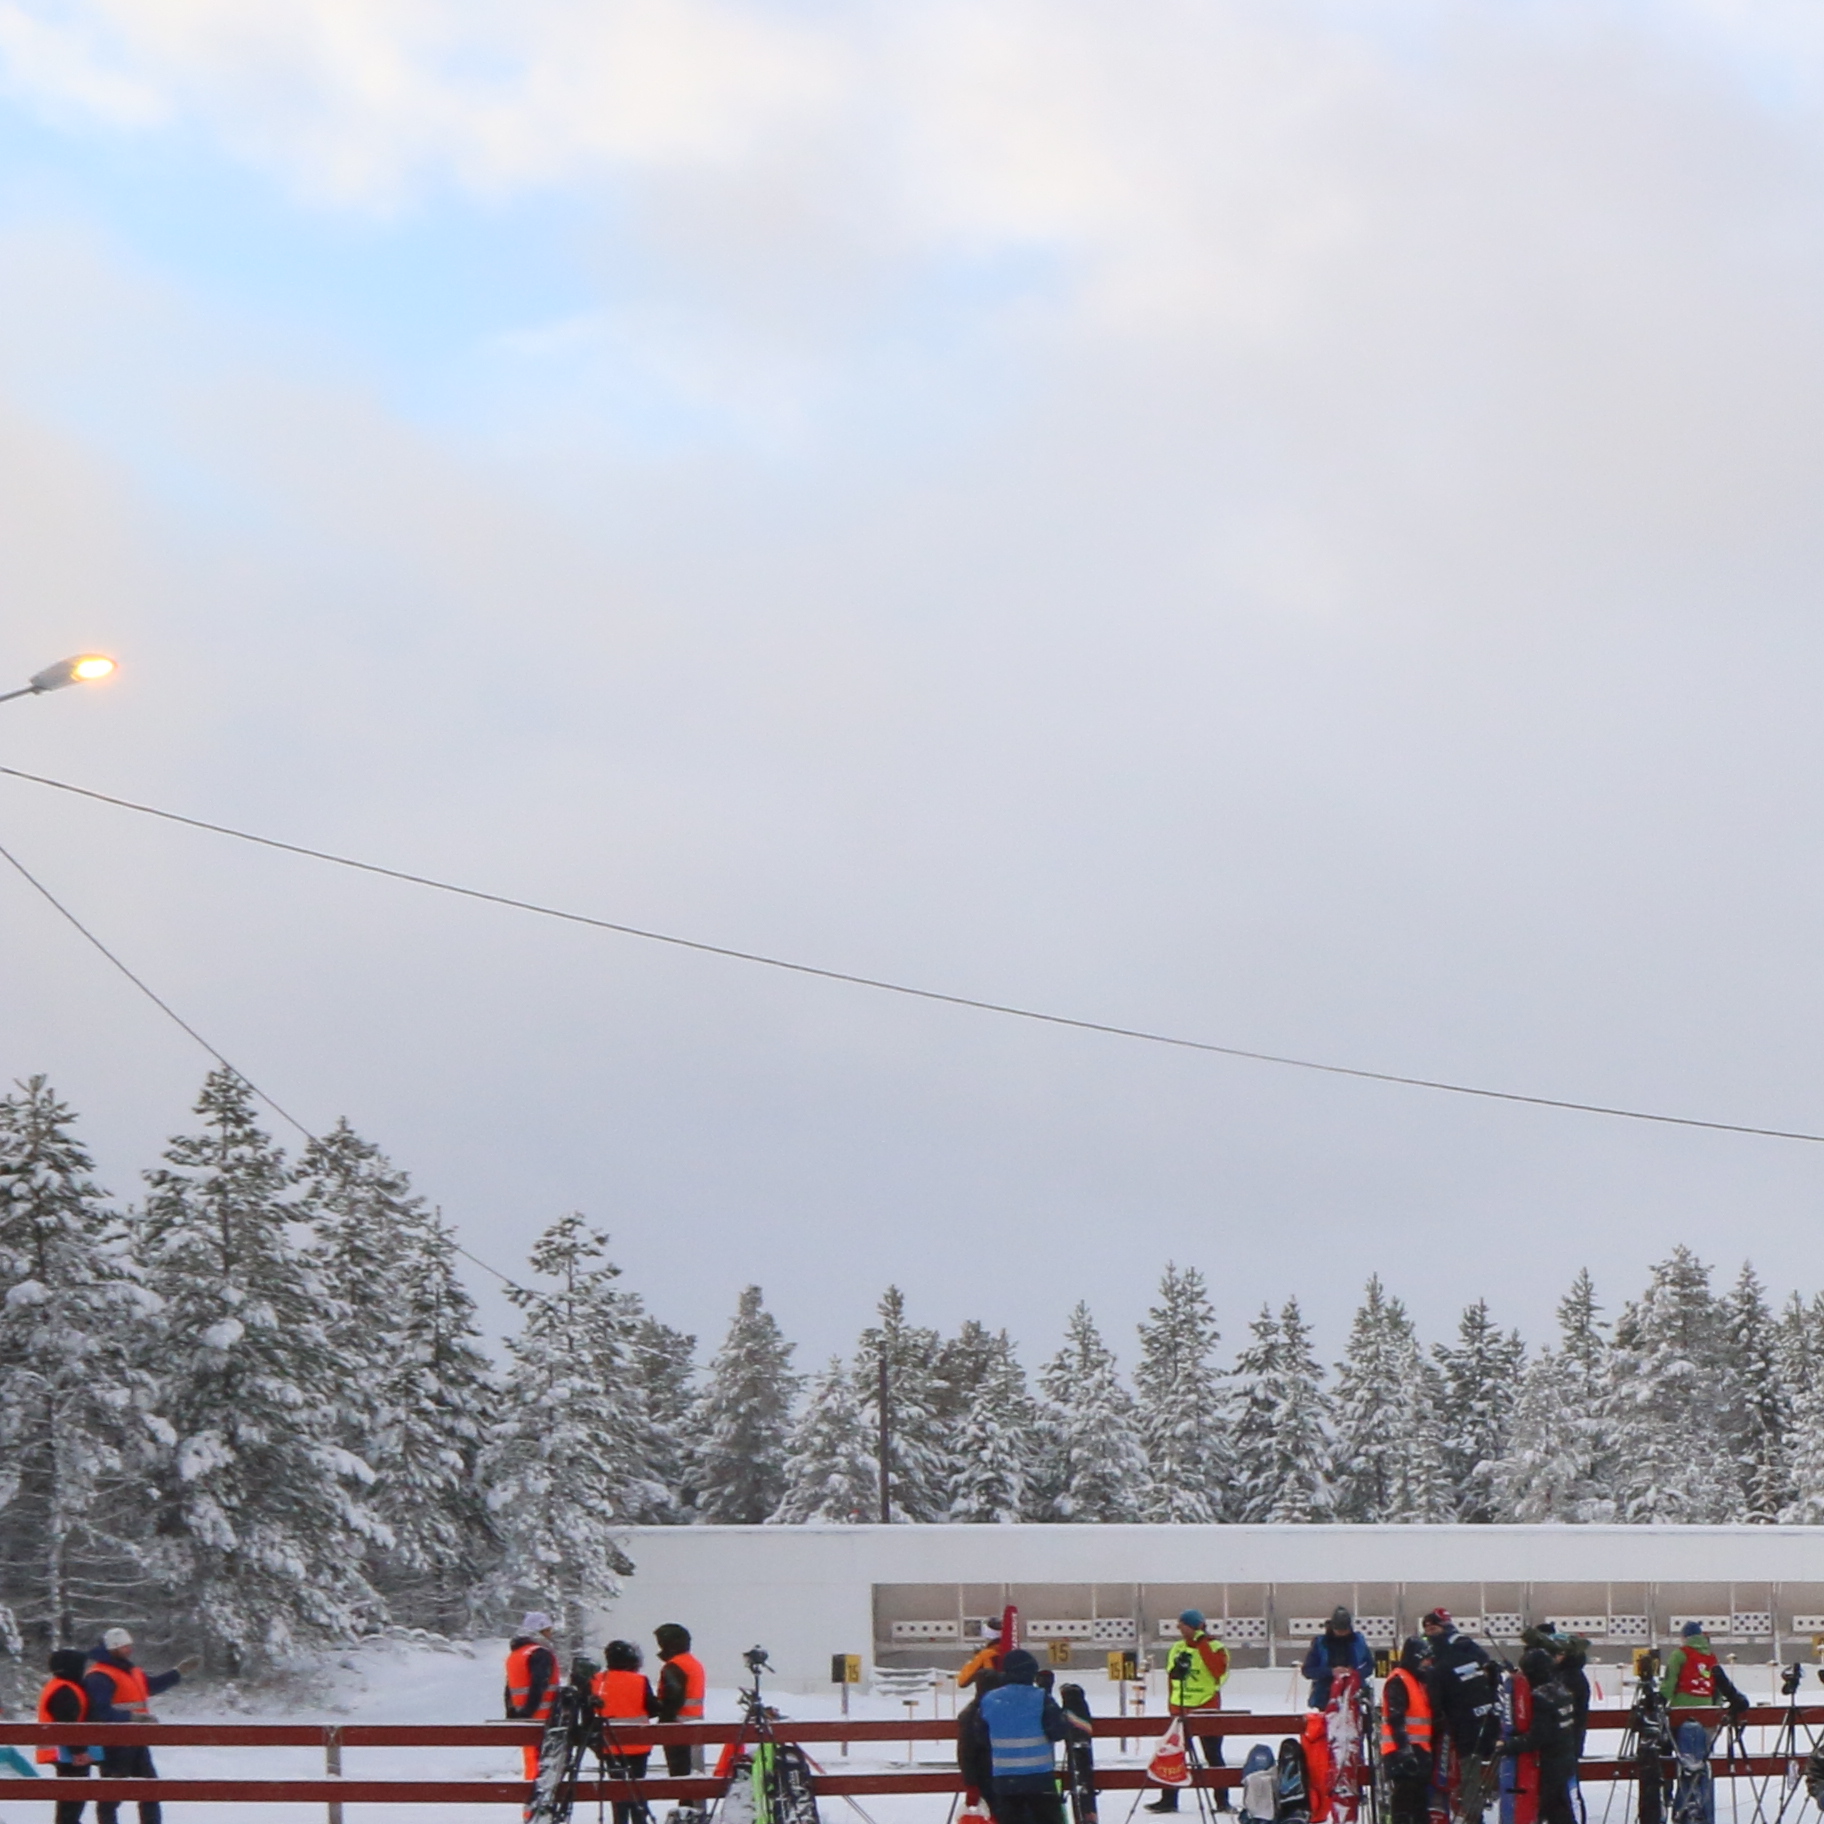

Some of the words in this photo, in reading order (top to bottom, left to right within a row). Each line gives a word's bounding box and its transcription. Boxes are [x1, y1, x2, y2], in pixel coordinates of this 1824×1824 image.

[1051, 1644, 1068, 1662] 15
[849, 1665, 858, 1680] 15
[1110, 1662, 1120, 1679] 15
